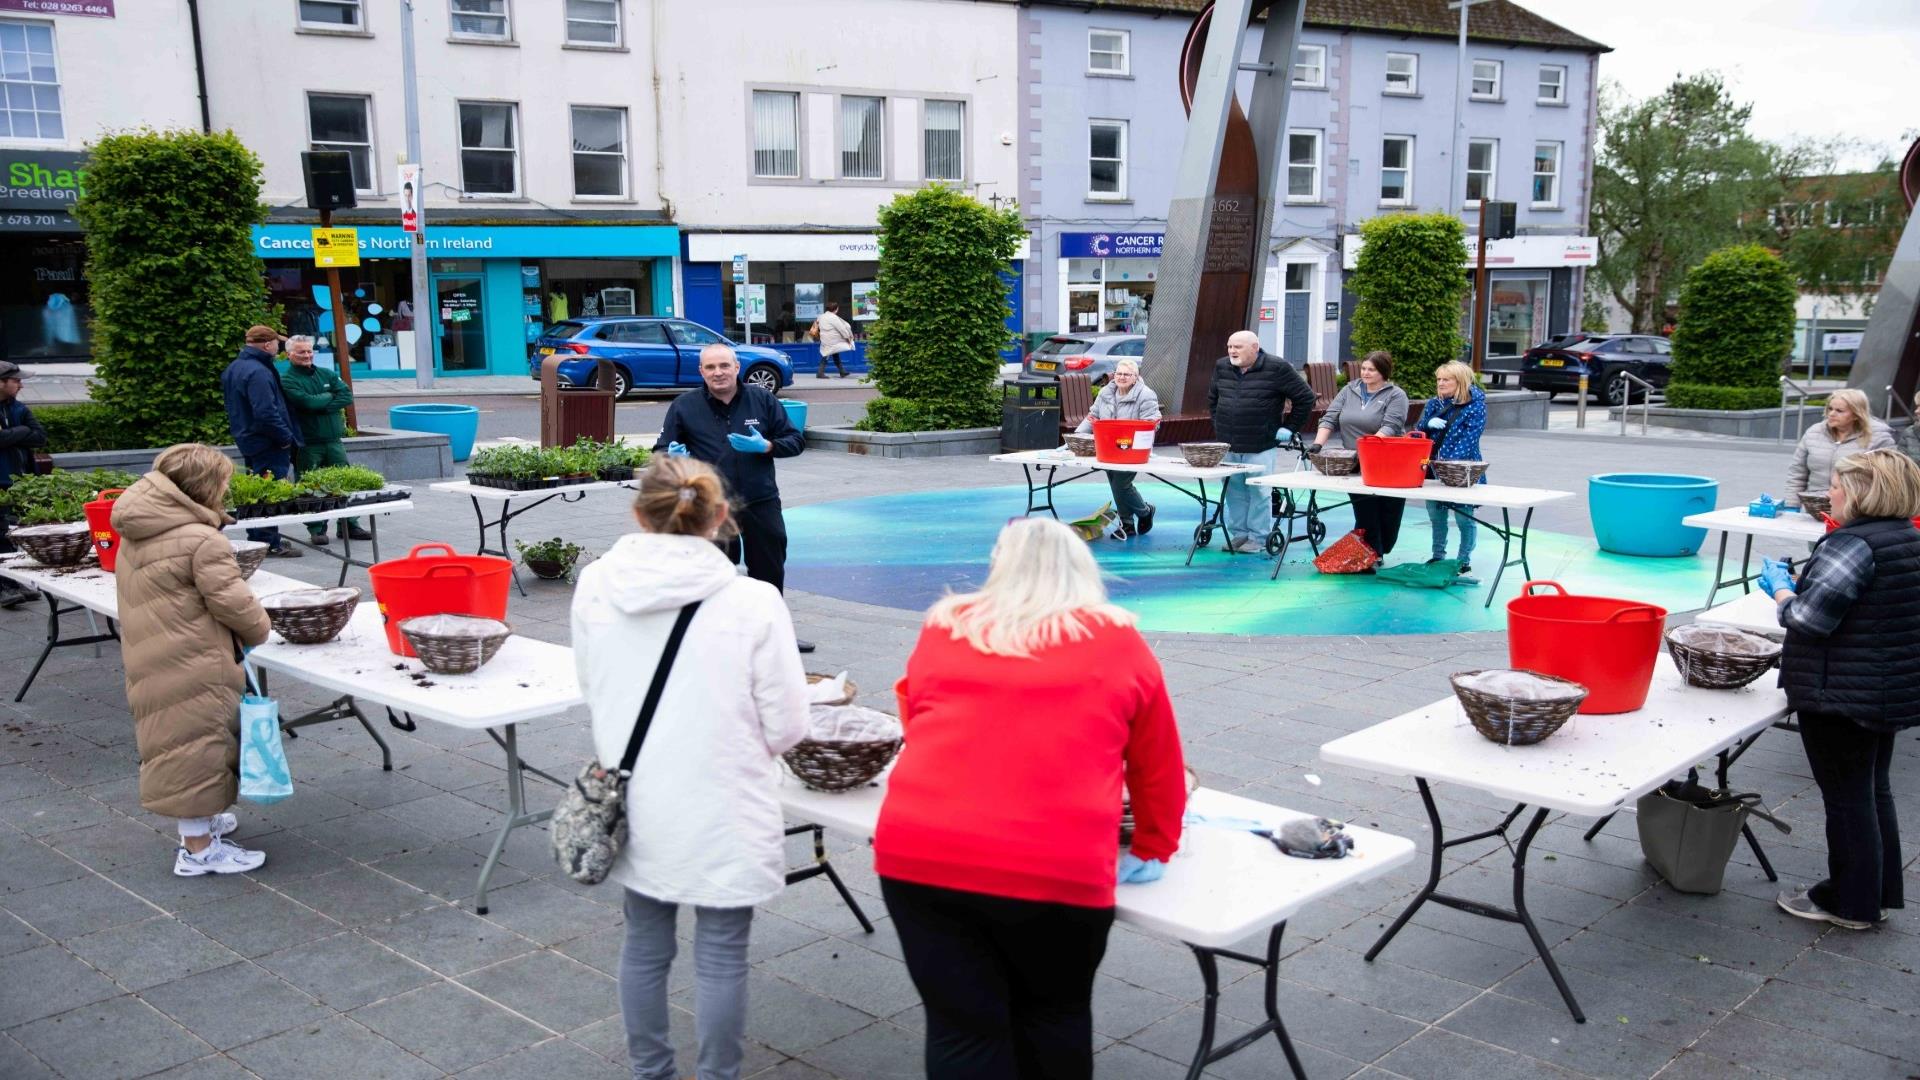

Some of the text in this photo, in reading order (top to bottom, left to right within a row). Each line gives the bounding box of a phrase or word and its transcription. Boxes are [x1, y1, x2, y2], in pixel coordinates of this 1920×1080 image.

[23, 0, 108, 14] Tel: 028 9263 4464
[1211, 199, 1240, 212] 1662
[7, 215, 31, 225] 678
[35, 215, 56, 225] 701
[443, 236, 492, 249] Ireland
[1115, 236, 1155, 246] CANCER
[839, 242, 877, 252] everyday
